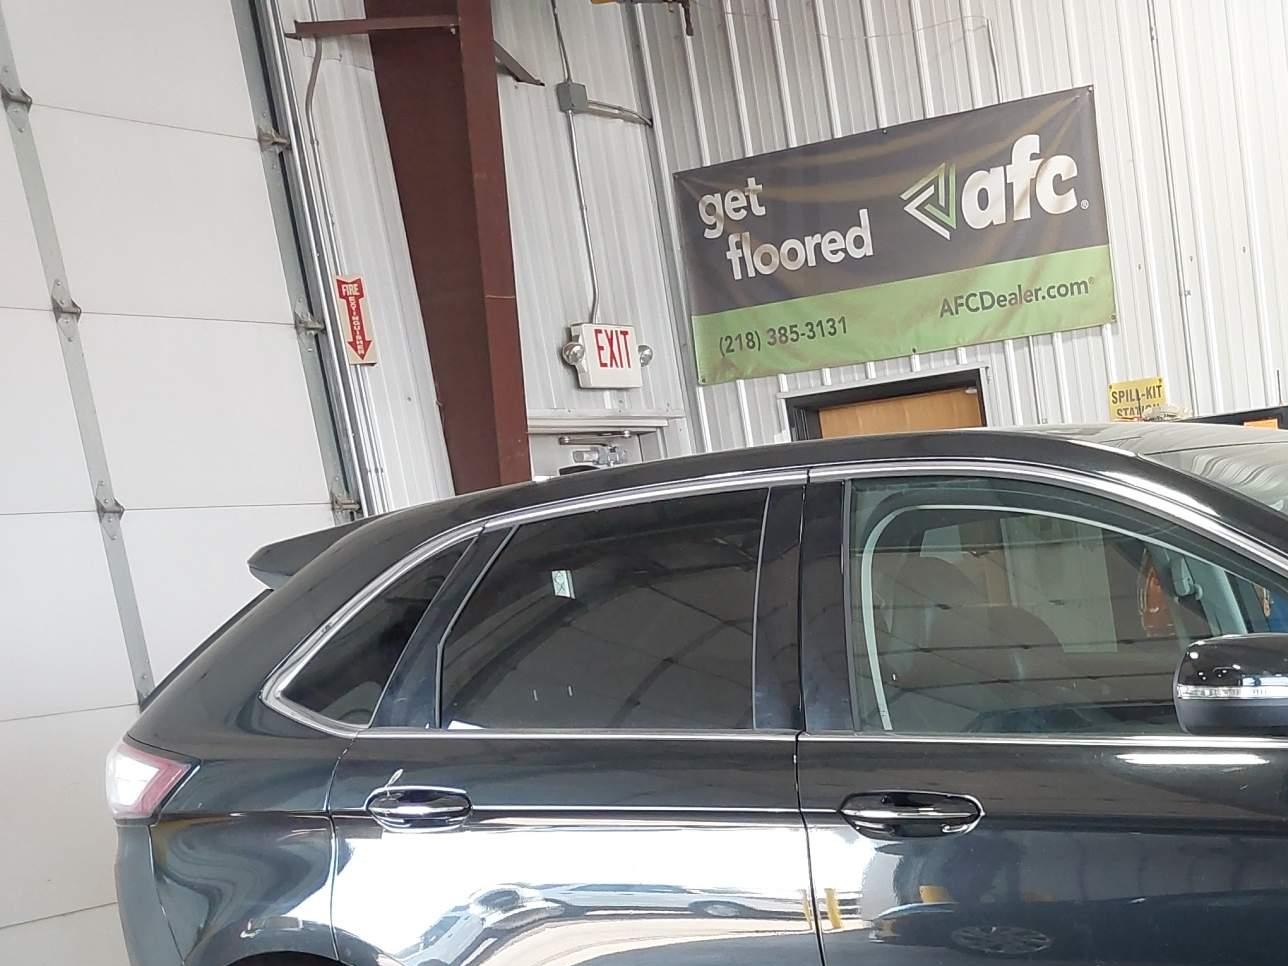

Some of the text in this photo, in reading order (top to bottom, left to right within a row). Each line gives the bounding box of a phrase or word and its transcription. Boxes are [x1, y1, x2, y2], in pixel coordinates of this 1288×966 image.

[699, 177, 766, 239] get
[726, 208, 873, 280] floored
[342, 284, 360, 296] FIRE
[939, 277, 1089, 318] AFCDealer.com
[594, 328, 632, 369] EXIT
[719, 316, 847, 358] (218) 385-3131
[1111, 384, 1163, 405] SPILL-KIT
[1116, 402, 1161, 417] STATI
